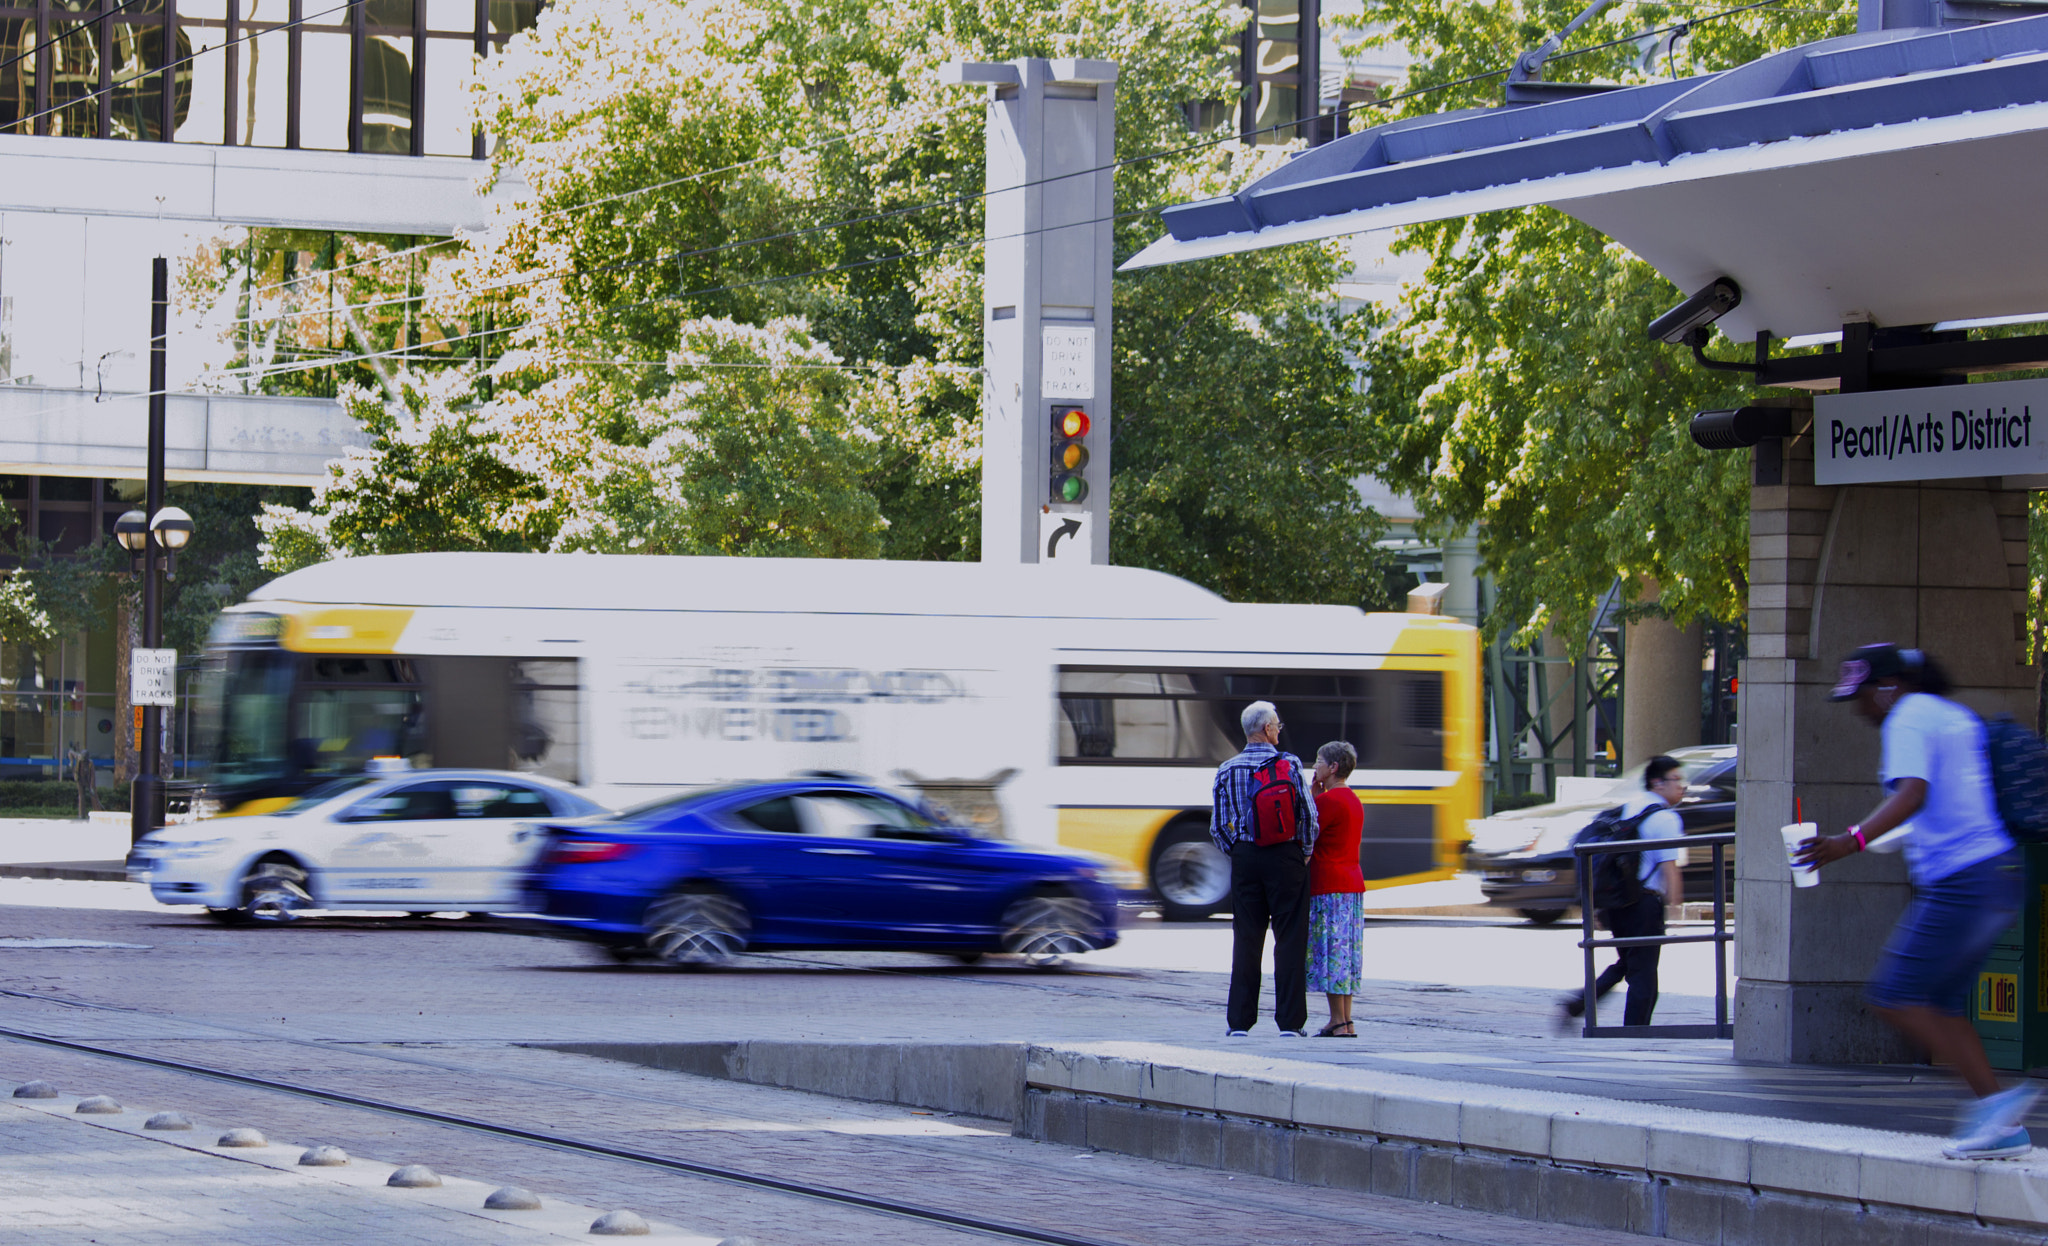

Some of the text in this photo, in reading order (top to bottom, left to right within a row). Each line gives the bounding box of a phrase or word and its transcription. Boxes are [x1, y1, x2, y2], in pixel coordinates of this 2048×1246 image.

[1046, 336, 1088, 346] DO NOT
[1051, 351, 1083, 361] DRIVE
[1059, 366, 1076, 376] ON
[1046, 380, 1090, 392] TRACKS
[1831, 412, 1945, 460] Pearl/Arts
[1952, 405, 2031, 451] District
[136, 655, 172, 664] DO NOT
[140, 667, 168, 676] DRIVE
[147, 678, 161, 687] ON
[136, 690, 173, 698] TRACKS
[1980, 977, 1992, 1011] al
